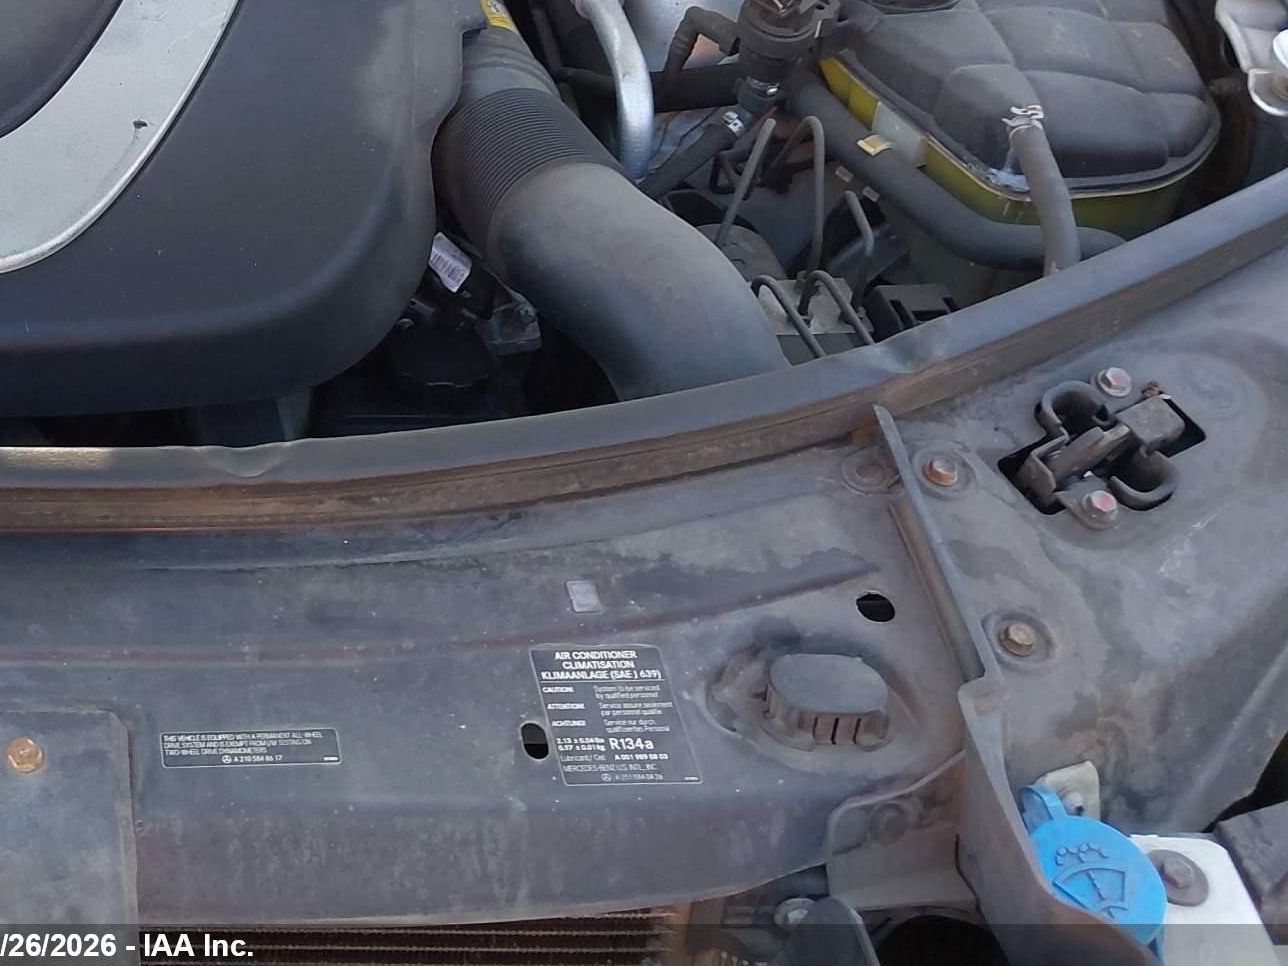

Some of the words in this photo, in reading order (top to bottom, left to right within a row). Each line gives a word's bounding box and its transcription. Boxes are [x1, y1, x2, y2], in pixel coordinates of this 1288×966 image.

[572, 651, 637, 659] CONDITIONER
[562, 661, 635, 669] CLIMATISATION
[541, 671, 609, 679] KLIMAANLAGE
[610, 670, 631, 680] (SAE
[639, 670, 661, 679] 639)
[609, 738, 654, 750] R134a
